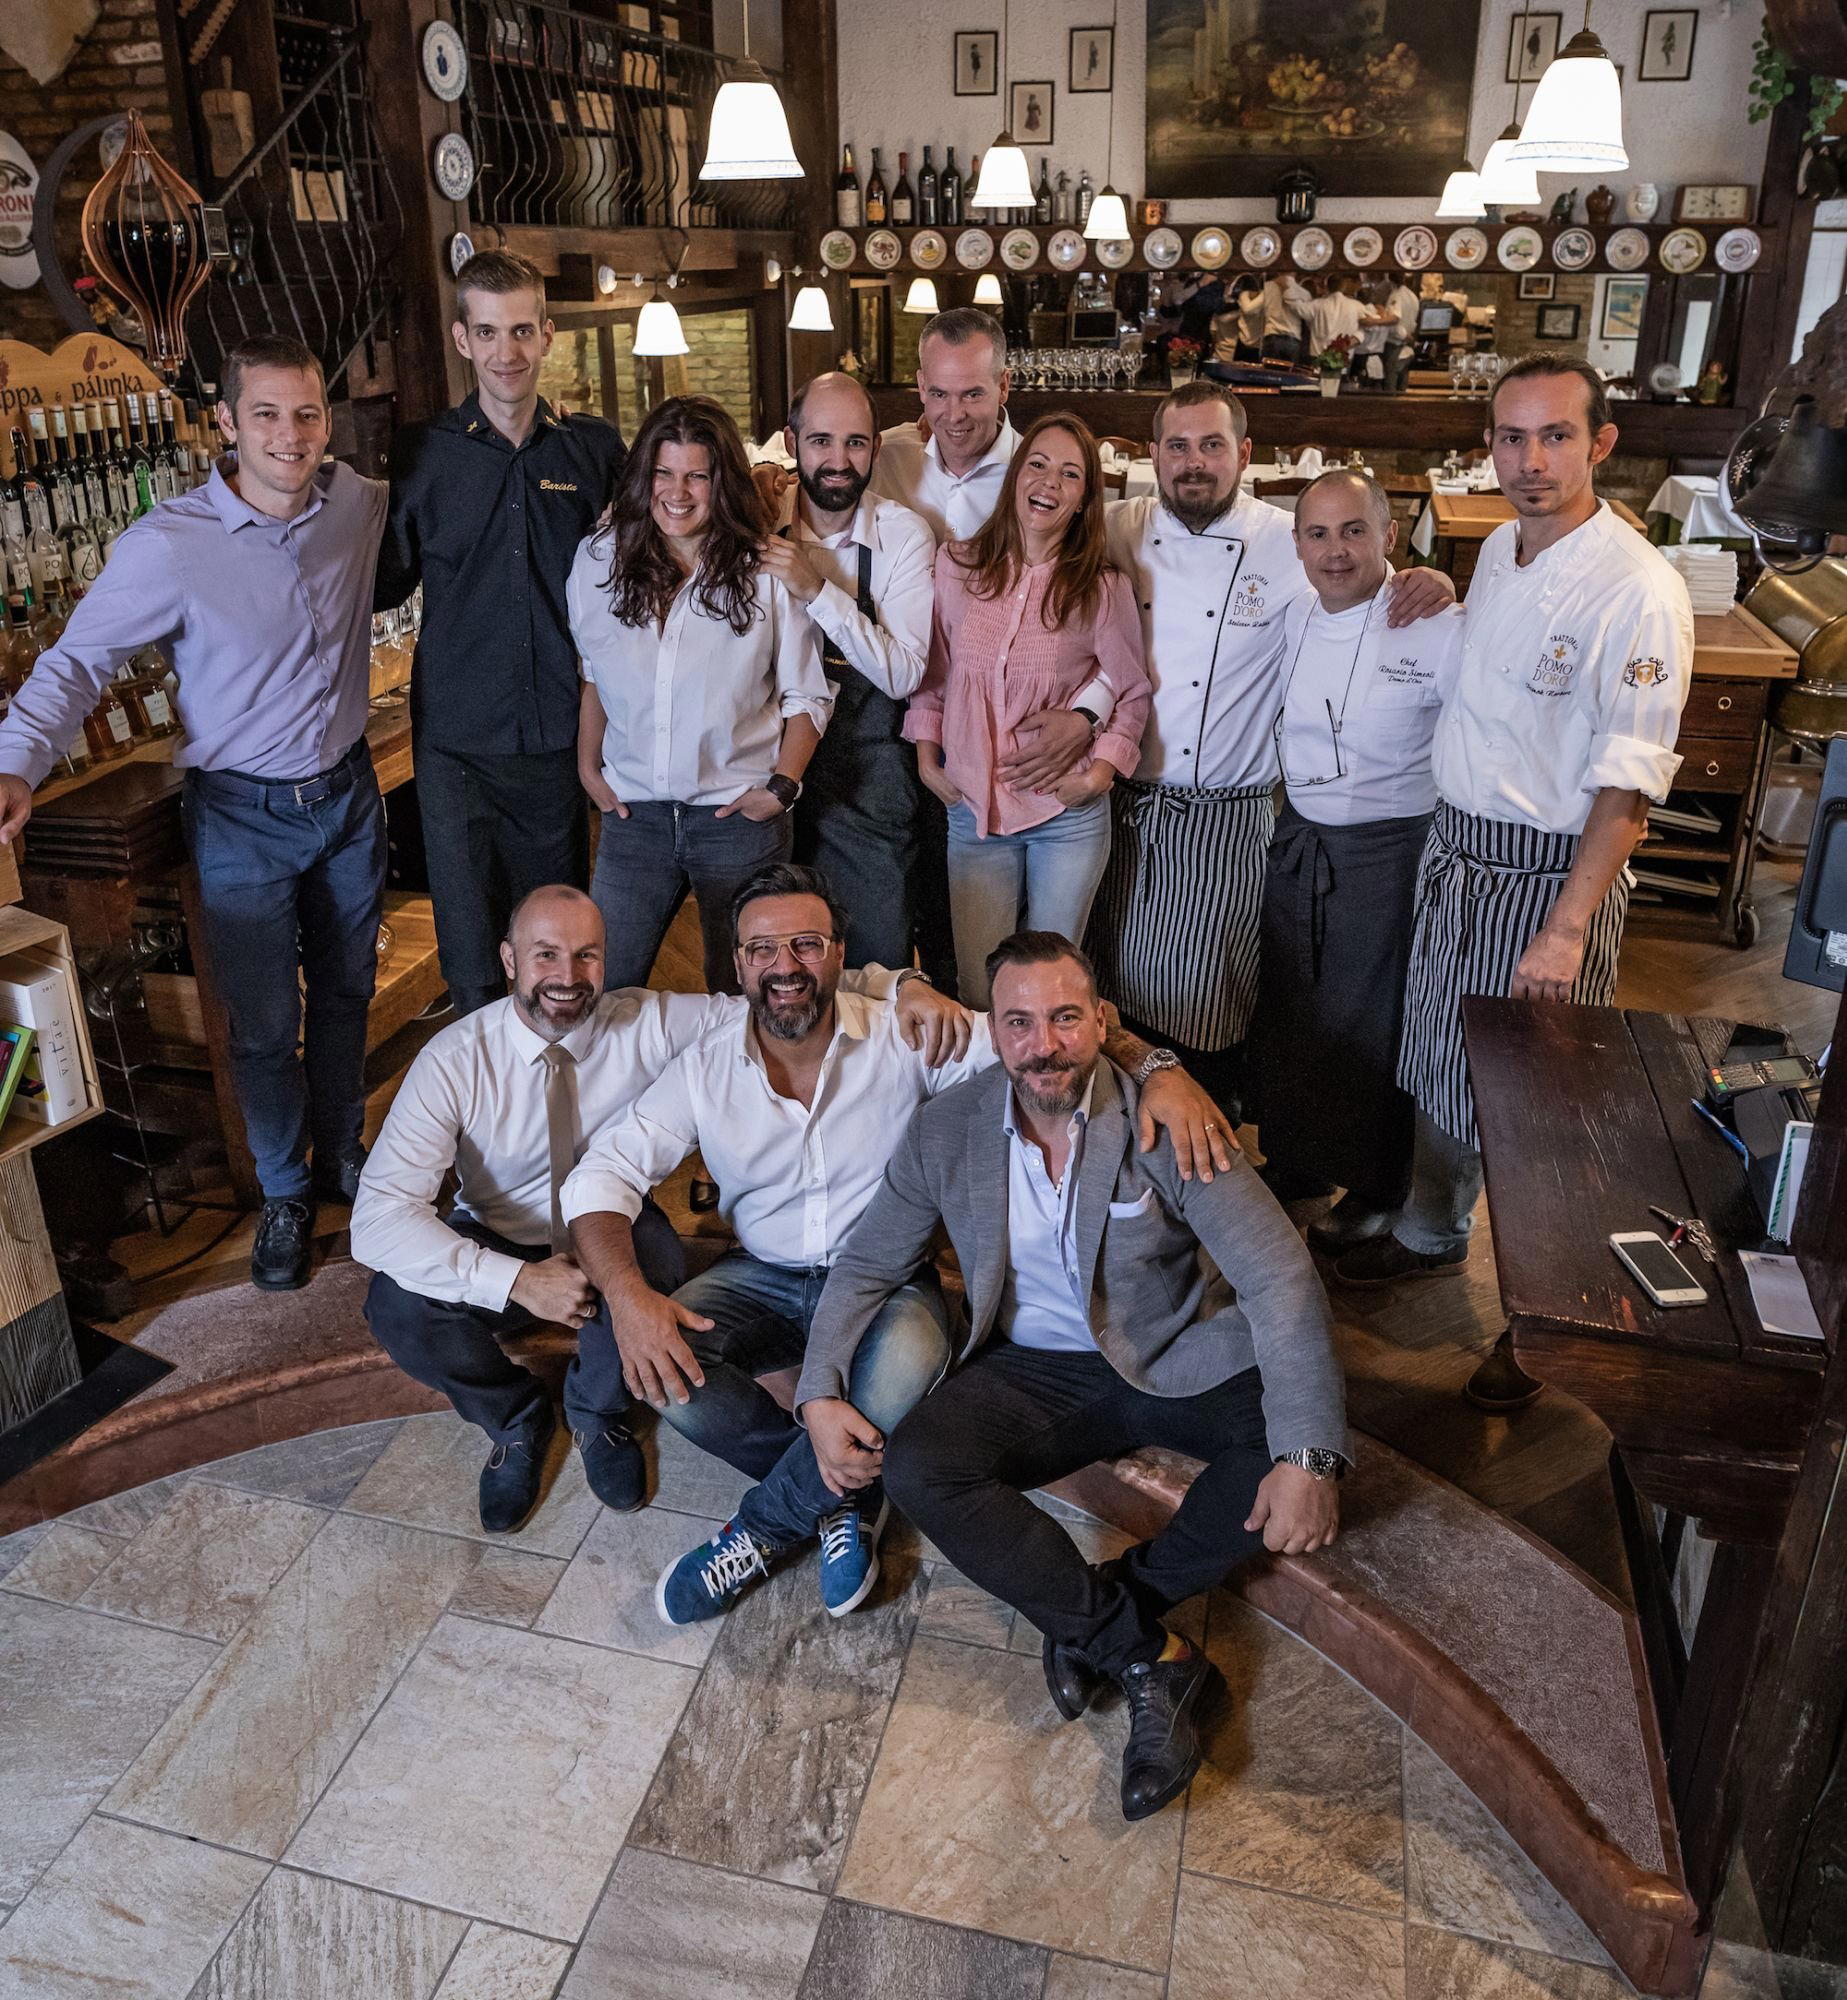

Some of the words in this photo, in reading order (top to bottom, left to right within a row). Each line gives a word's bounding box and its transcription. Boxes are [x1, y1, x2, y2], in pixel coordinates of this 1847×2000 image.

[0, 385, 43, 416] ppa
[72, 373, 145, 402] pálinka
[540, 479, 577, 491] Barista
[1240, 574, 1269, 587] TRATTORIA
[1235, 591, 1265, 608] POMO
[1233, 604, 1264, 617] D'ORO
[1400, 657, 1417, 667] Chef
[1537, 653, 1573, 676] POMO
[1532, 668, 1569, 686] D'ORO
